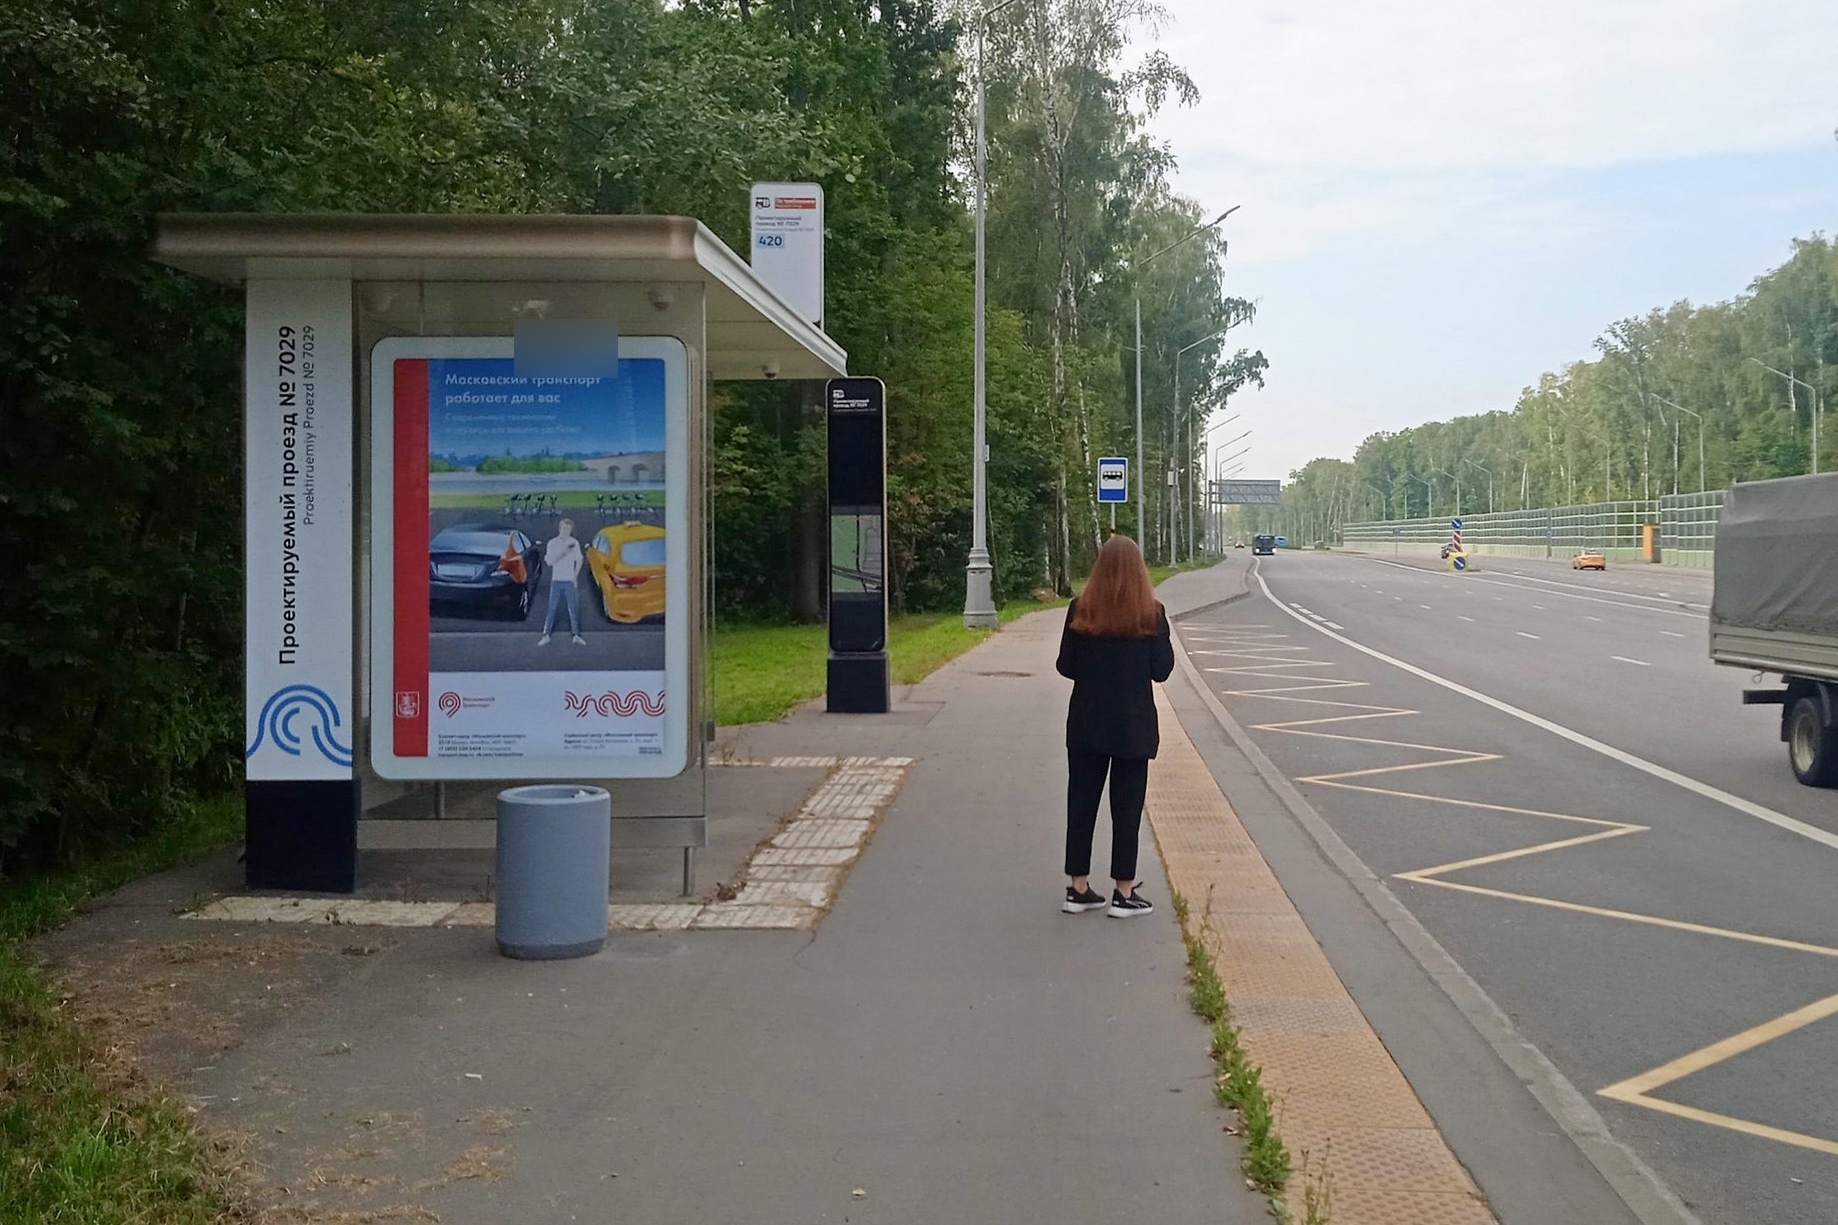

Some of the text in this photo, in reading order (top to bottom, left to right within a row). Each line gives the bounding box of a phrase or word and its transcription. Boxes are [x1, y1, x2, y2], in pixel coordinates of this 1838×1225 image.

[758, 236, 783, 246] 420
[532, 377, 601, 388] транспорт
[445, 390, 561, 406] работает для вас
[303, 325, 317, 525] Proektiruemiy Proezd № 7029
[279, 325, 299, 664] Проектируемый проезд № 7029
